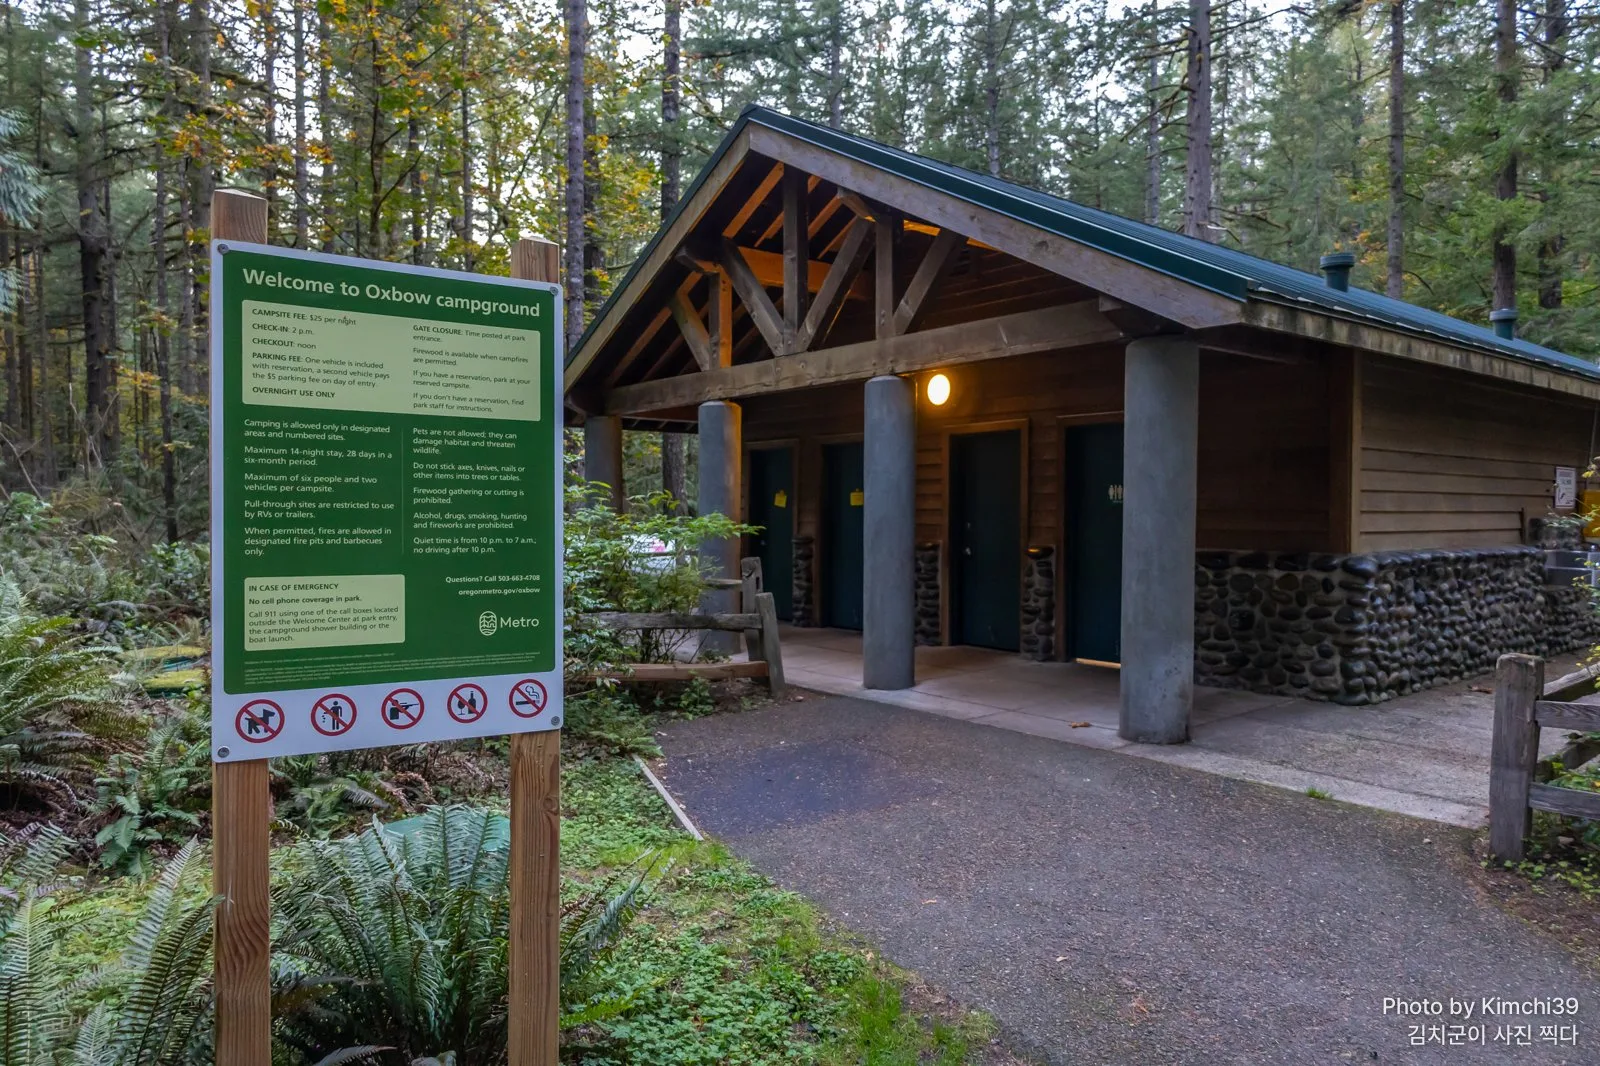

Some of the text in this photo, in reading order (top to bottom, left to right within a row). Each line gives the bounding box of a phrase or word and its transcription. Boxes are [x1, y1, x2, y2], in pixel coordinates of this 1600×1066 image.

[243, 268, 540, 316] Welcome to Oxbow campground
[252, 309, 291, 318] CAMPSITE
[338, 316, 356, 326] night
[253, 353, 286, 361] PARKING
[253, 387, 297, 395] OVERNIGHT
[245, 419, 280, 429] Camping
[323, 424, 338, 432] only
[350, 425, 390, 433] designated
[245, 446, 287, 454] Maximum
[291, 448, 324, 456] 14-night
[359, 451, 376, 459] days
[314, 475, 342, 483] people
[245, 500, 296, 509] Pull-through
[245, 511, 254, 519] by
[501, 513, 527, 521] hunting
[245, 527, 270, 535] When
[245, 538, 290, 546] designated
[425, 546, 450, 554] driving
[459, 588, 540, 596] oregonmetro.gov/oxbow
[277, 597, 299, 605] phone
[302, 596, 333, 604] coverage
[500, 616, 539, 628] Metro
[264, 625, 309, 634] campground
[339, 623, 367, 631] building
